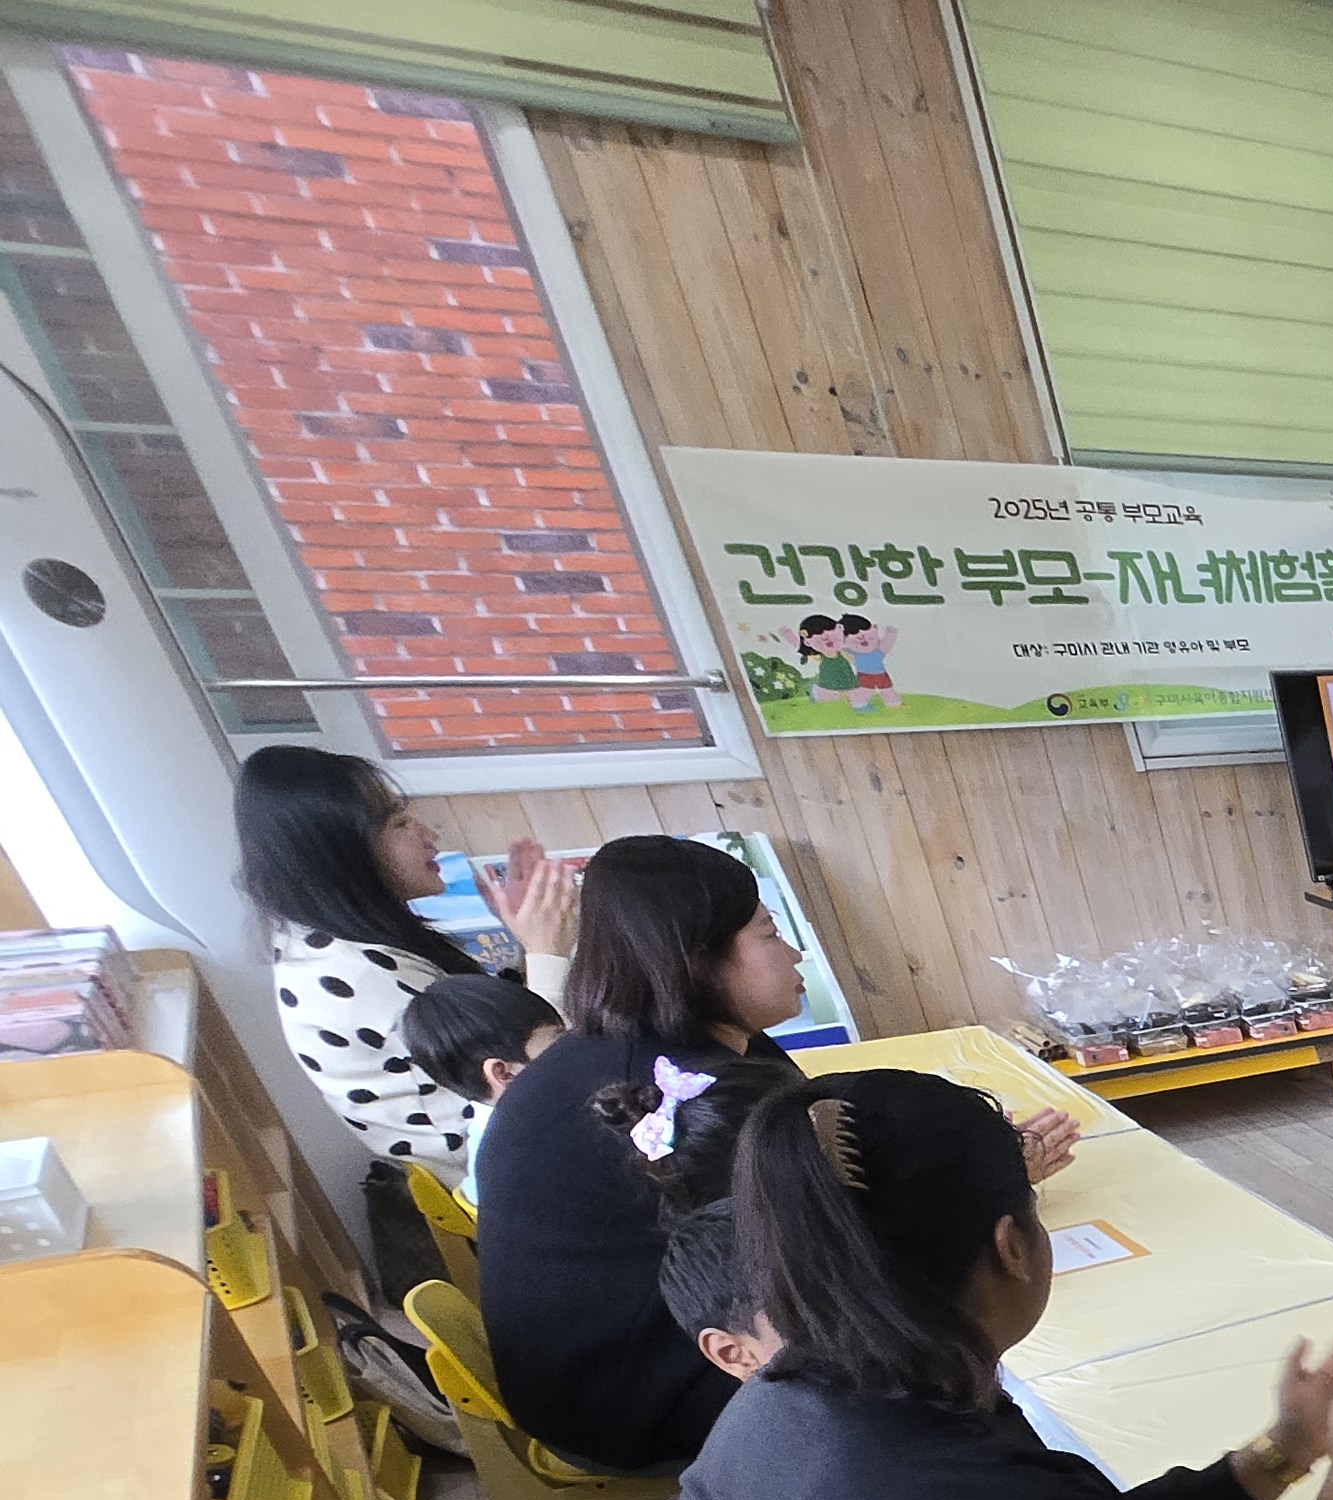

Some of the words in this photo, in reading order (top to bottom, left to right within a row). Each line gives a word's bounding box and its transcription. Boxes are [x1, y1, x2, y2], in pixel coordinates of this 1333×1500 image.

[988, 497, 1071, 521] 2025년
[1075, 499, 1118, 523] 공통
[1122, 502, 1204, 525] 부모교육
[723, 542, 945, 607] 건강한
[1012, 643, 1050, 658] 대상:
[1052, 642, 1099, 656] 구미시
[1100, 641, 1131, 656] 관내
[1133, 640, 1160, 655] 기관
[1163, 640, 1204, 654] 영유아
[1205, 638, 1221, 652] 및
[1223, 638, 1251, 652] 부모
[1077, 697, 1109, 710] 교육부
